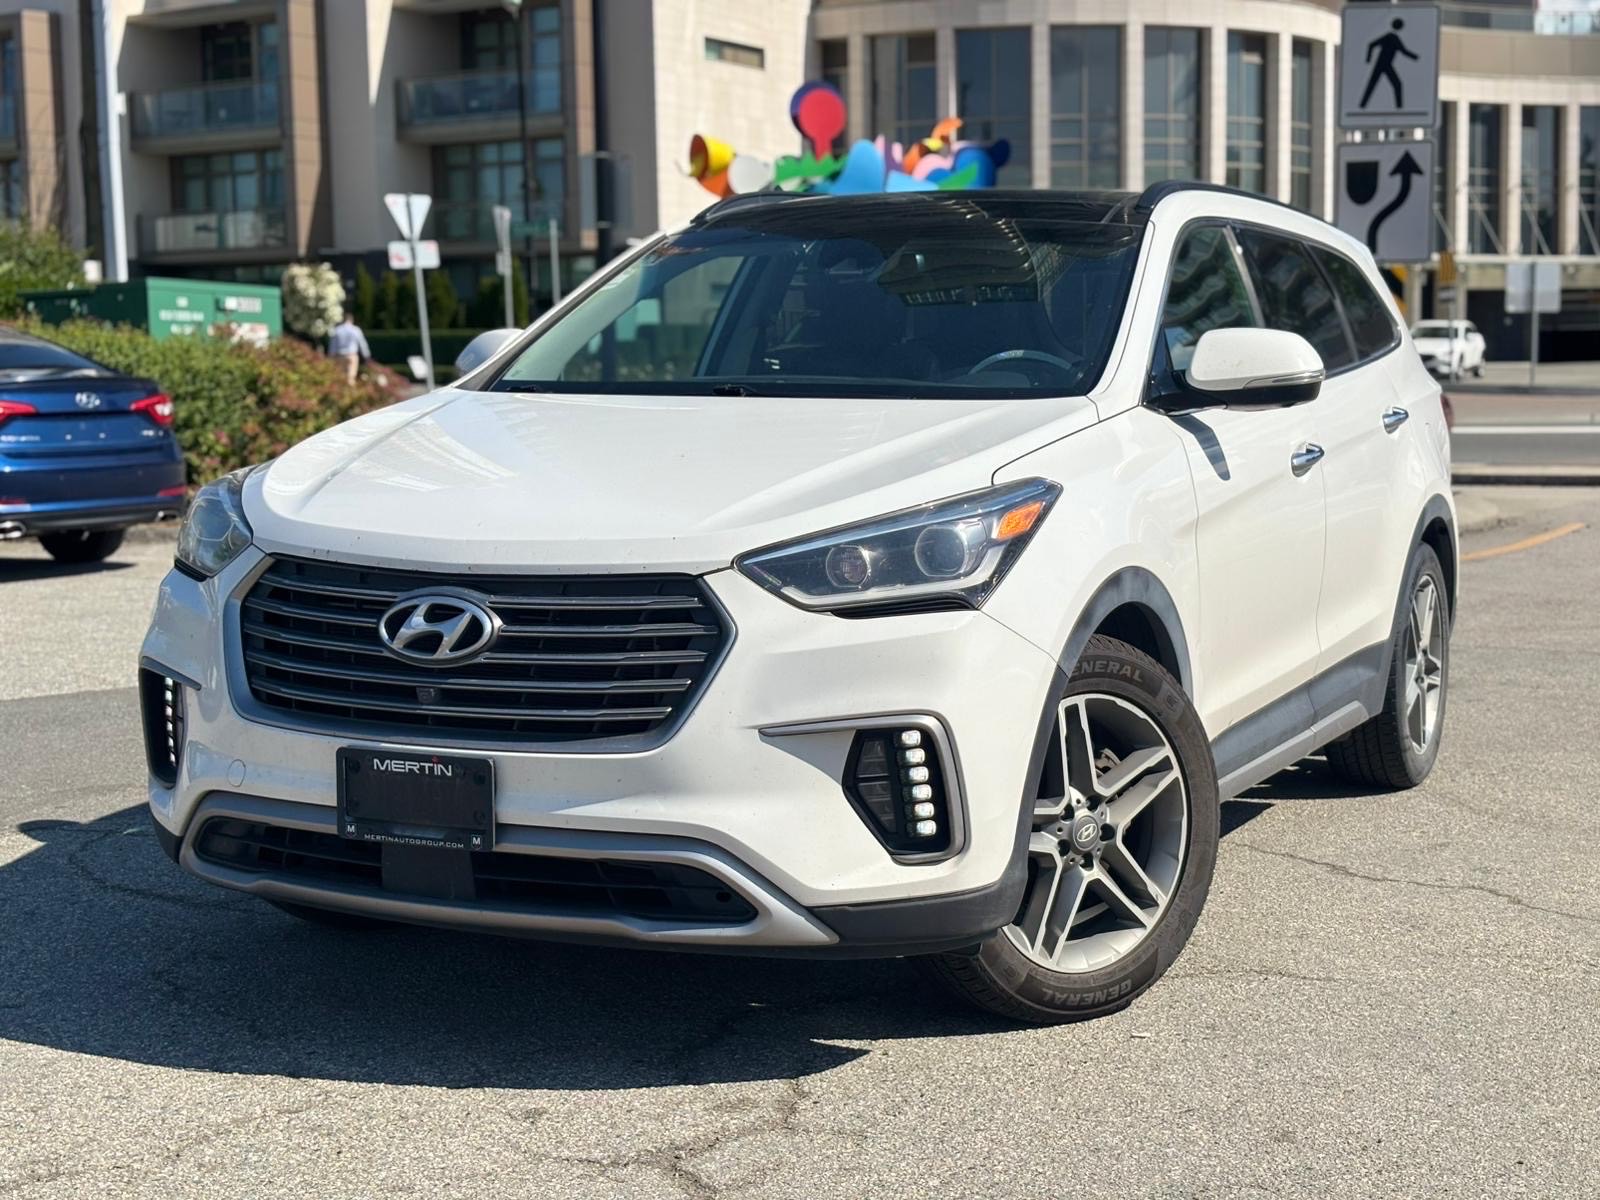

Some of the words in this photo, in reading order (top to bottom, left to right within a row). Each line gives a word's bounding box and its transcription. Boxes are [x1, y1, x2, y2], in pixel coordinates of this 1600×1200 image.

[373, 758, 452, 776] MERTIN
[364, 833, 464, 848] MERTINAUTOGROUP.COM
[1041, 978, 1133, 1006] GENERAL
